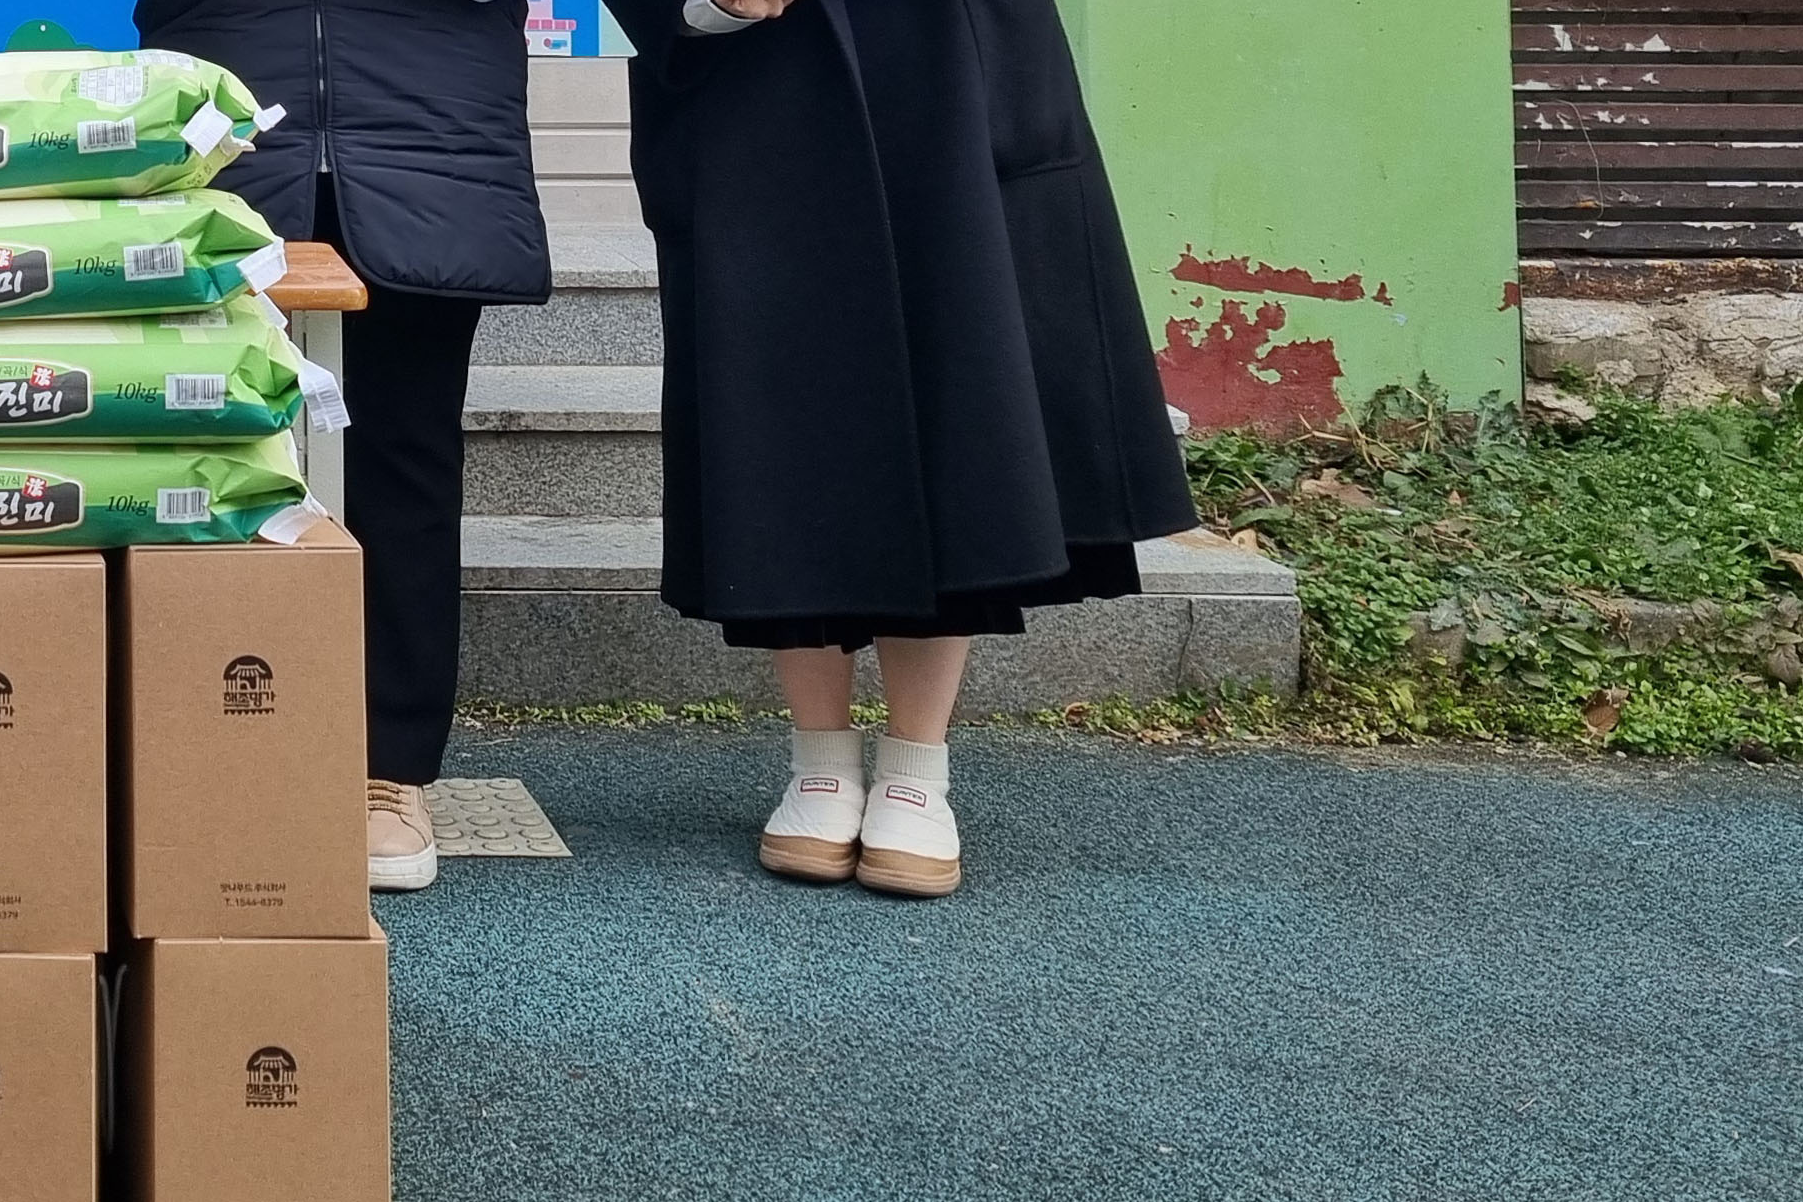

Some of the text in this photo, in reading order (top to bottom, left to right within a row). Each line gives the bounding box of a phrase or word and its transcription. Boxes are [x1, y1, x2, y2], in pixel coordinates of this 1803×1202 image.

[27, 131, 71, 150] 10kg
[74, 256, 117, 276] 10kg
[114, 382, 158, 403] 10kg
[106, 495, 150, 516] 10kg
